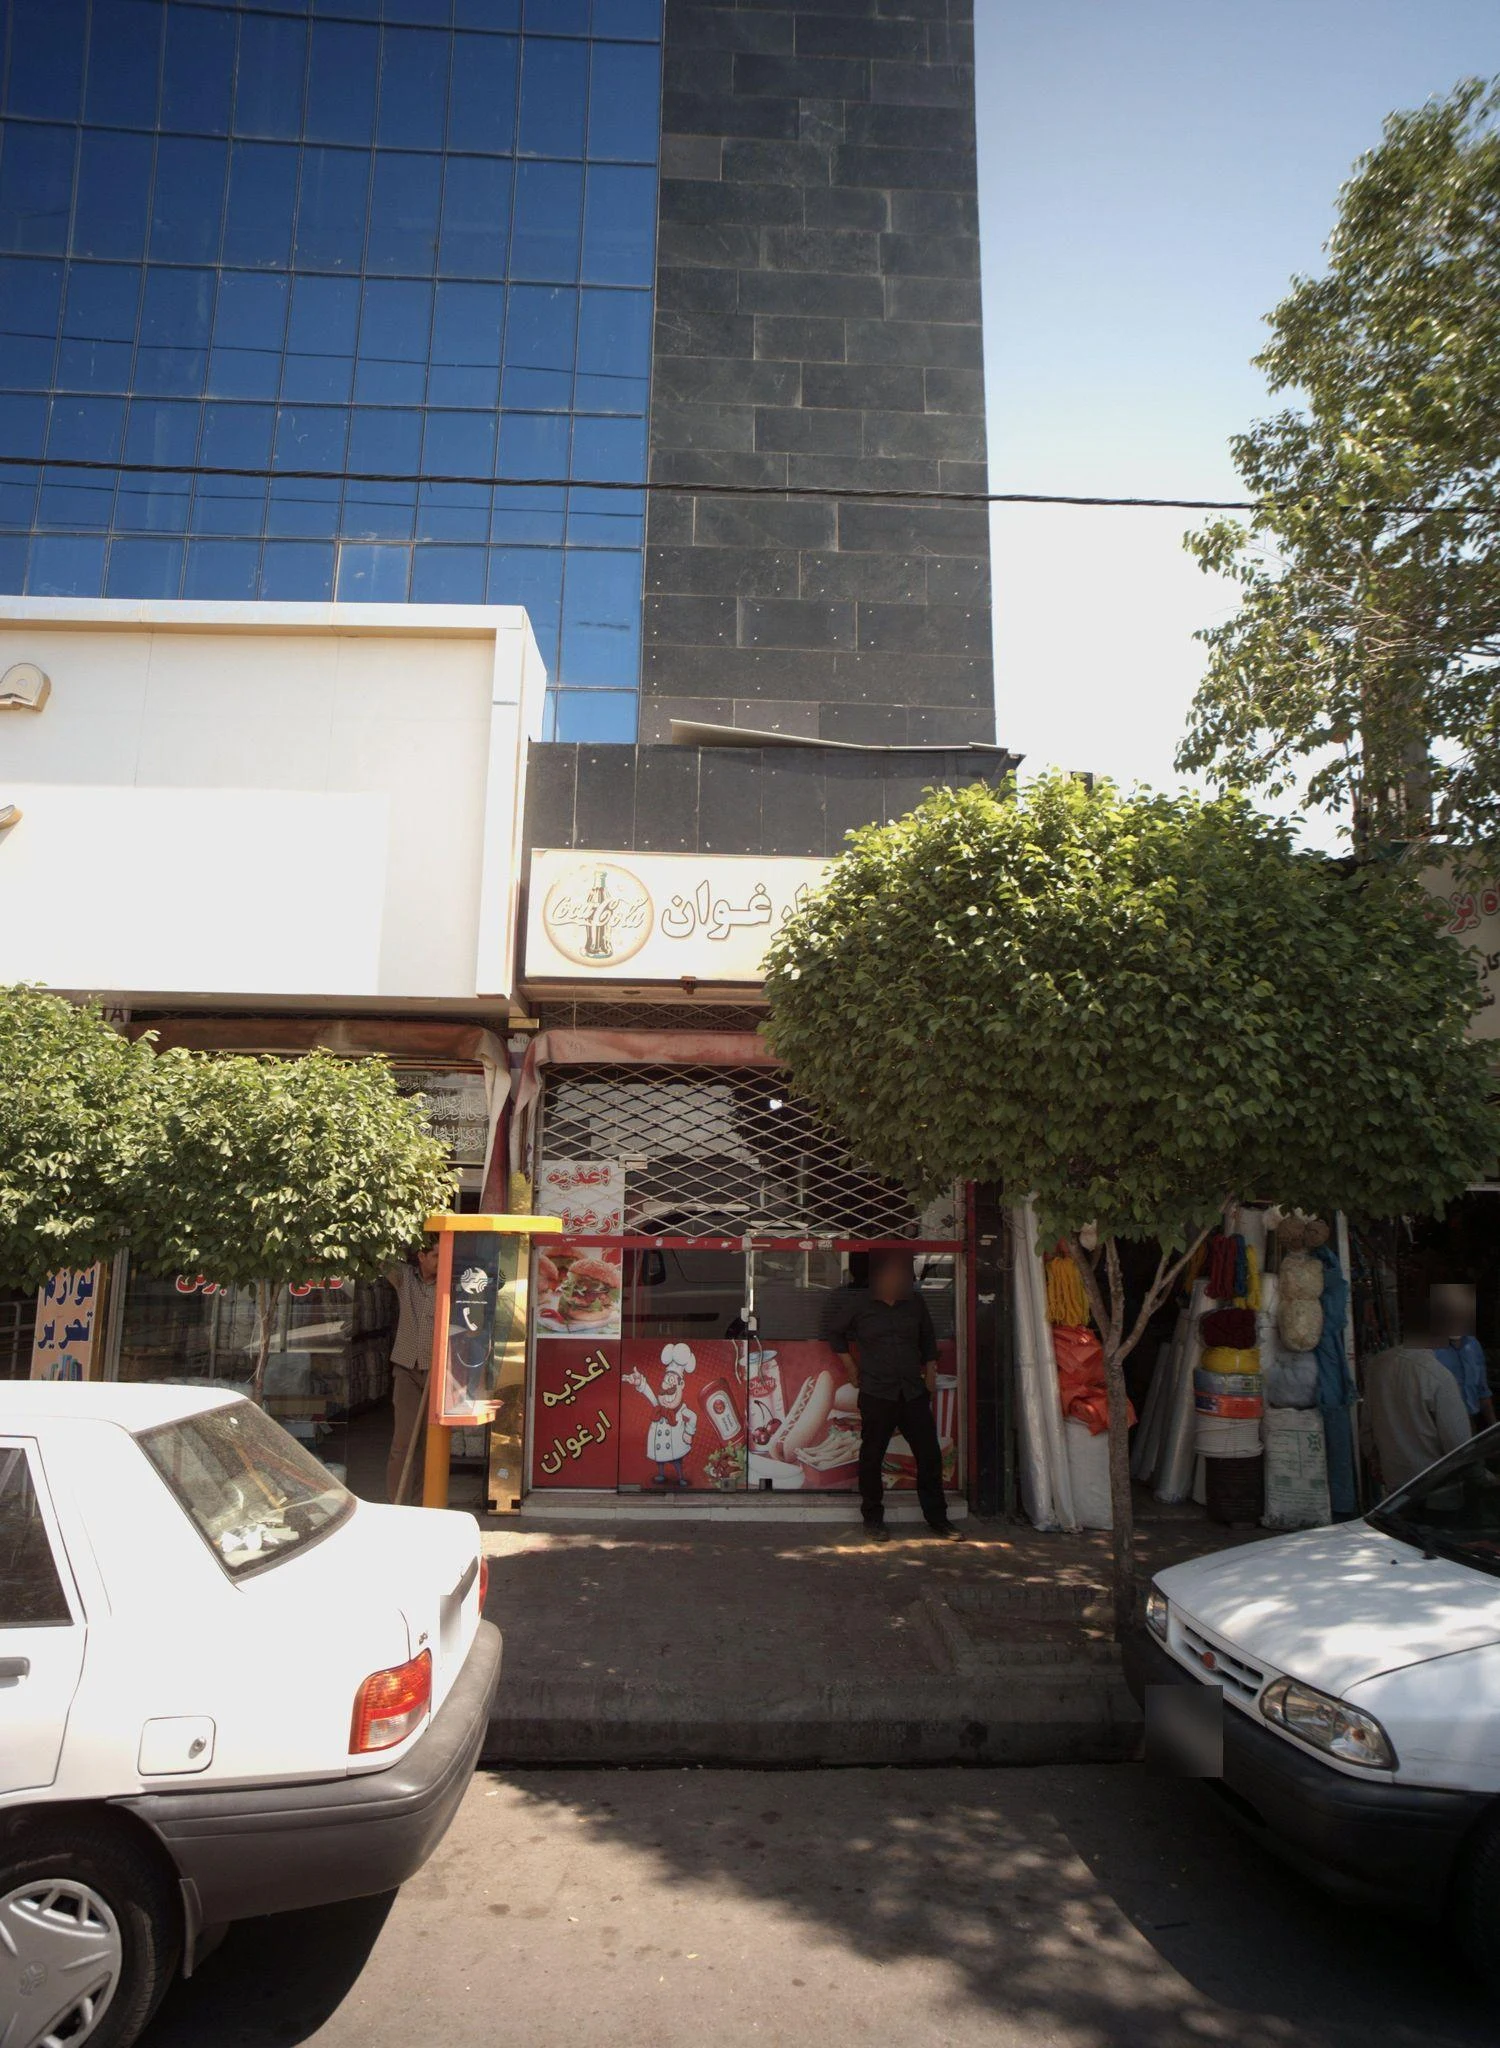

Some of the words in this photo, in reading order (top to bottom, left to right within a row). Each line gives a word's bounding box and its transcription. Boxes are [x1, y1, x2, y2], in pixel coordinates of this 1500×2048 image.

[547, 1165, 610, 1190] اغذیه
[555, 1207, 620, 1234] ارغوا
[44, 1269, 95, 1306] لوازم
[38, 1311, 93, 1350] تحریر
[542, 1349, 611, 1407] اغذیه
[541, 1410, 612, 1474] ارغوان
